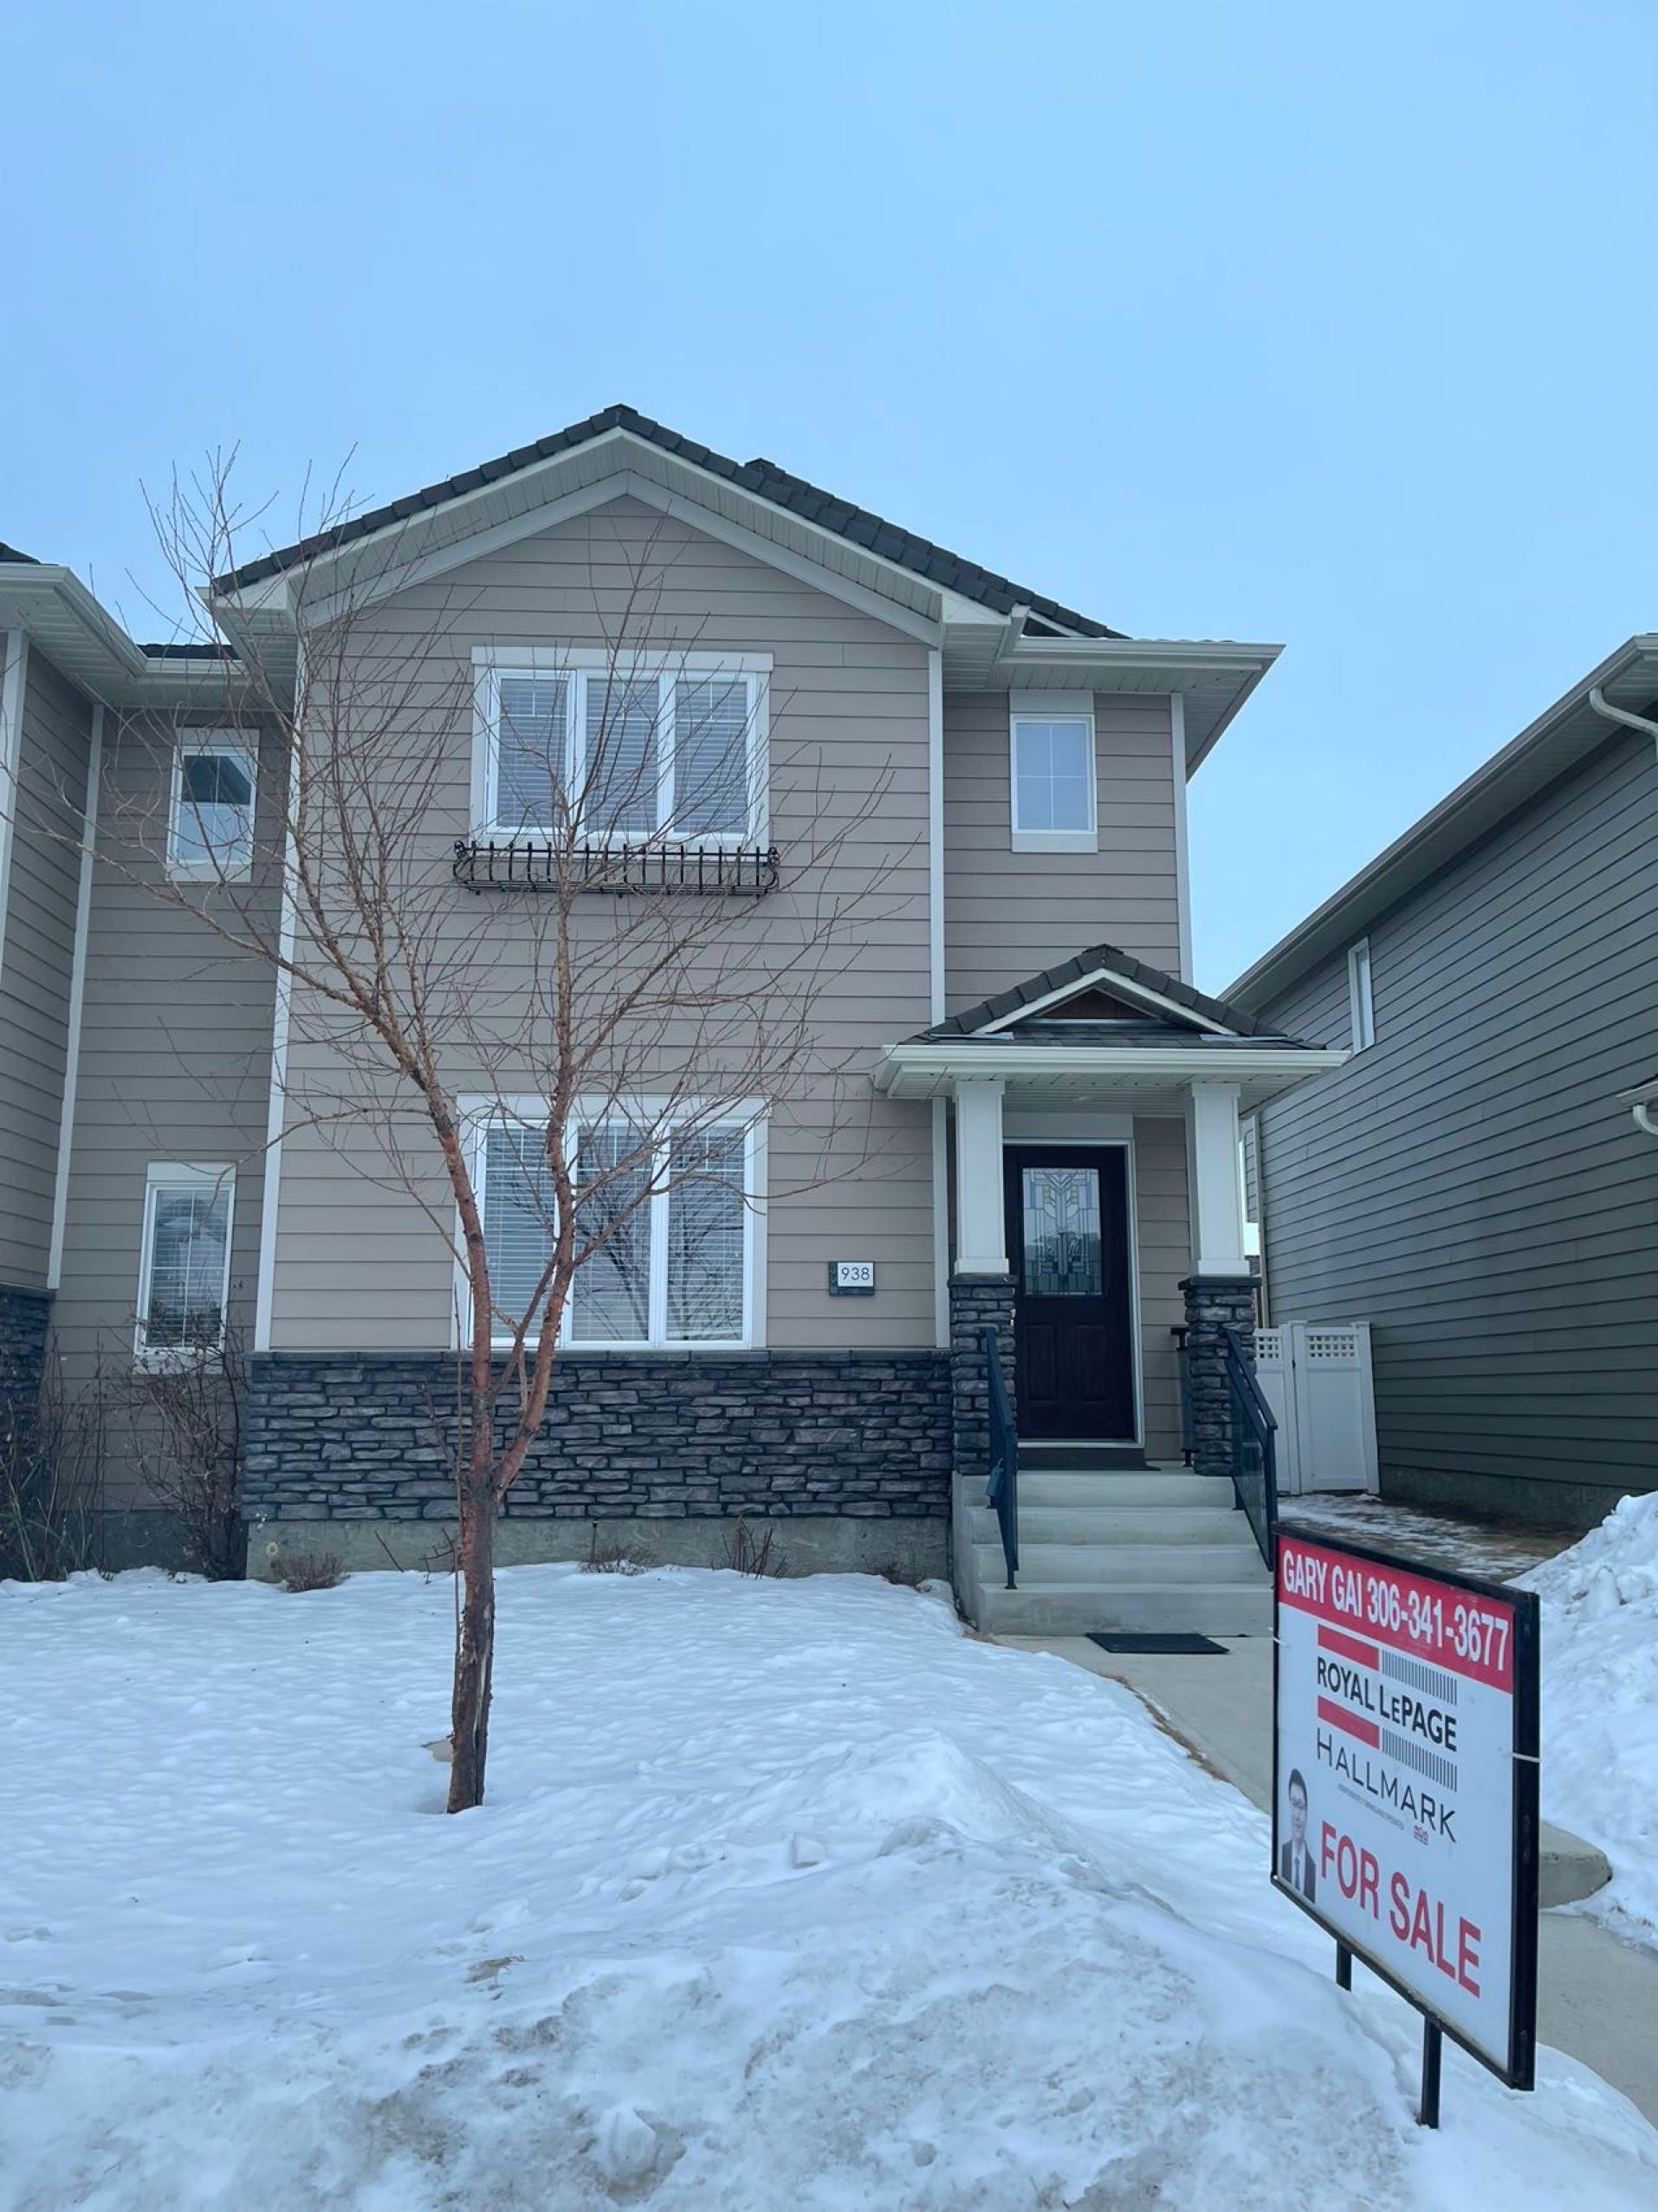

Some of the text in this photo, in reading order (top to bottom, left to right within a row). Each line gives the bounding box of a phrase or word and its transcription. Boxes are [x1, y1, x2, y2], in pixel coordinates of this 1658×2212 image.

[841, 1267, 870, 1280] 938
[1283, 1550, 1508, 1671] GARY GAI 306-341-3677
[1317, 1657, 1376, 1711] ROYAL
[1317, 1728, 1456, 1843] HALLMARK
[1321, 1820, 1481, 1998] FOR SALE
